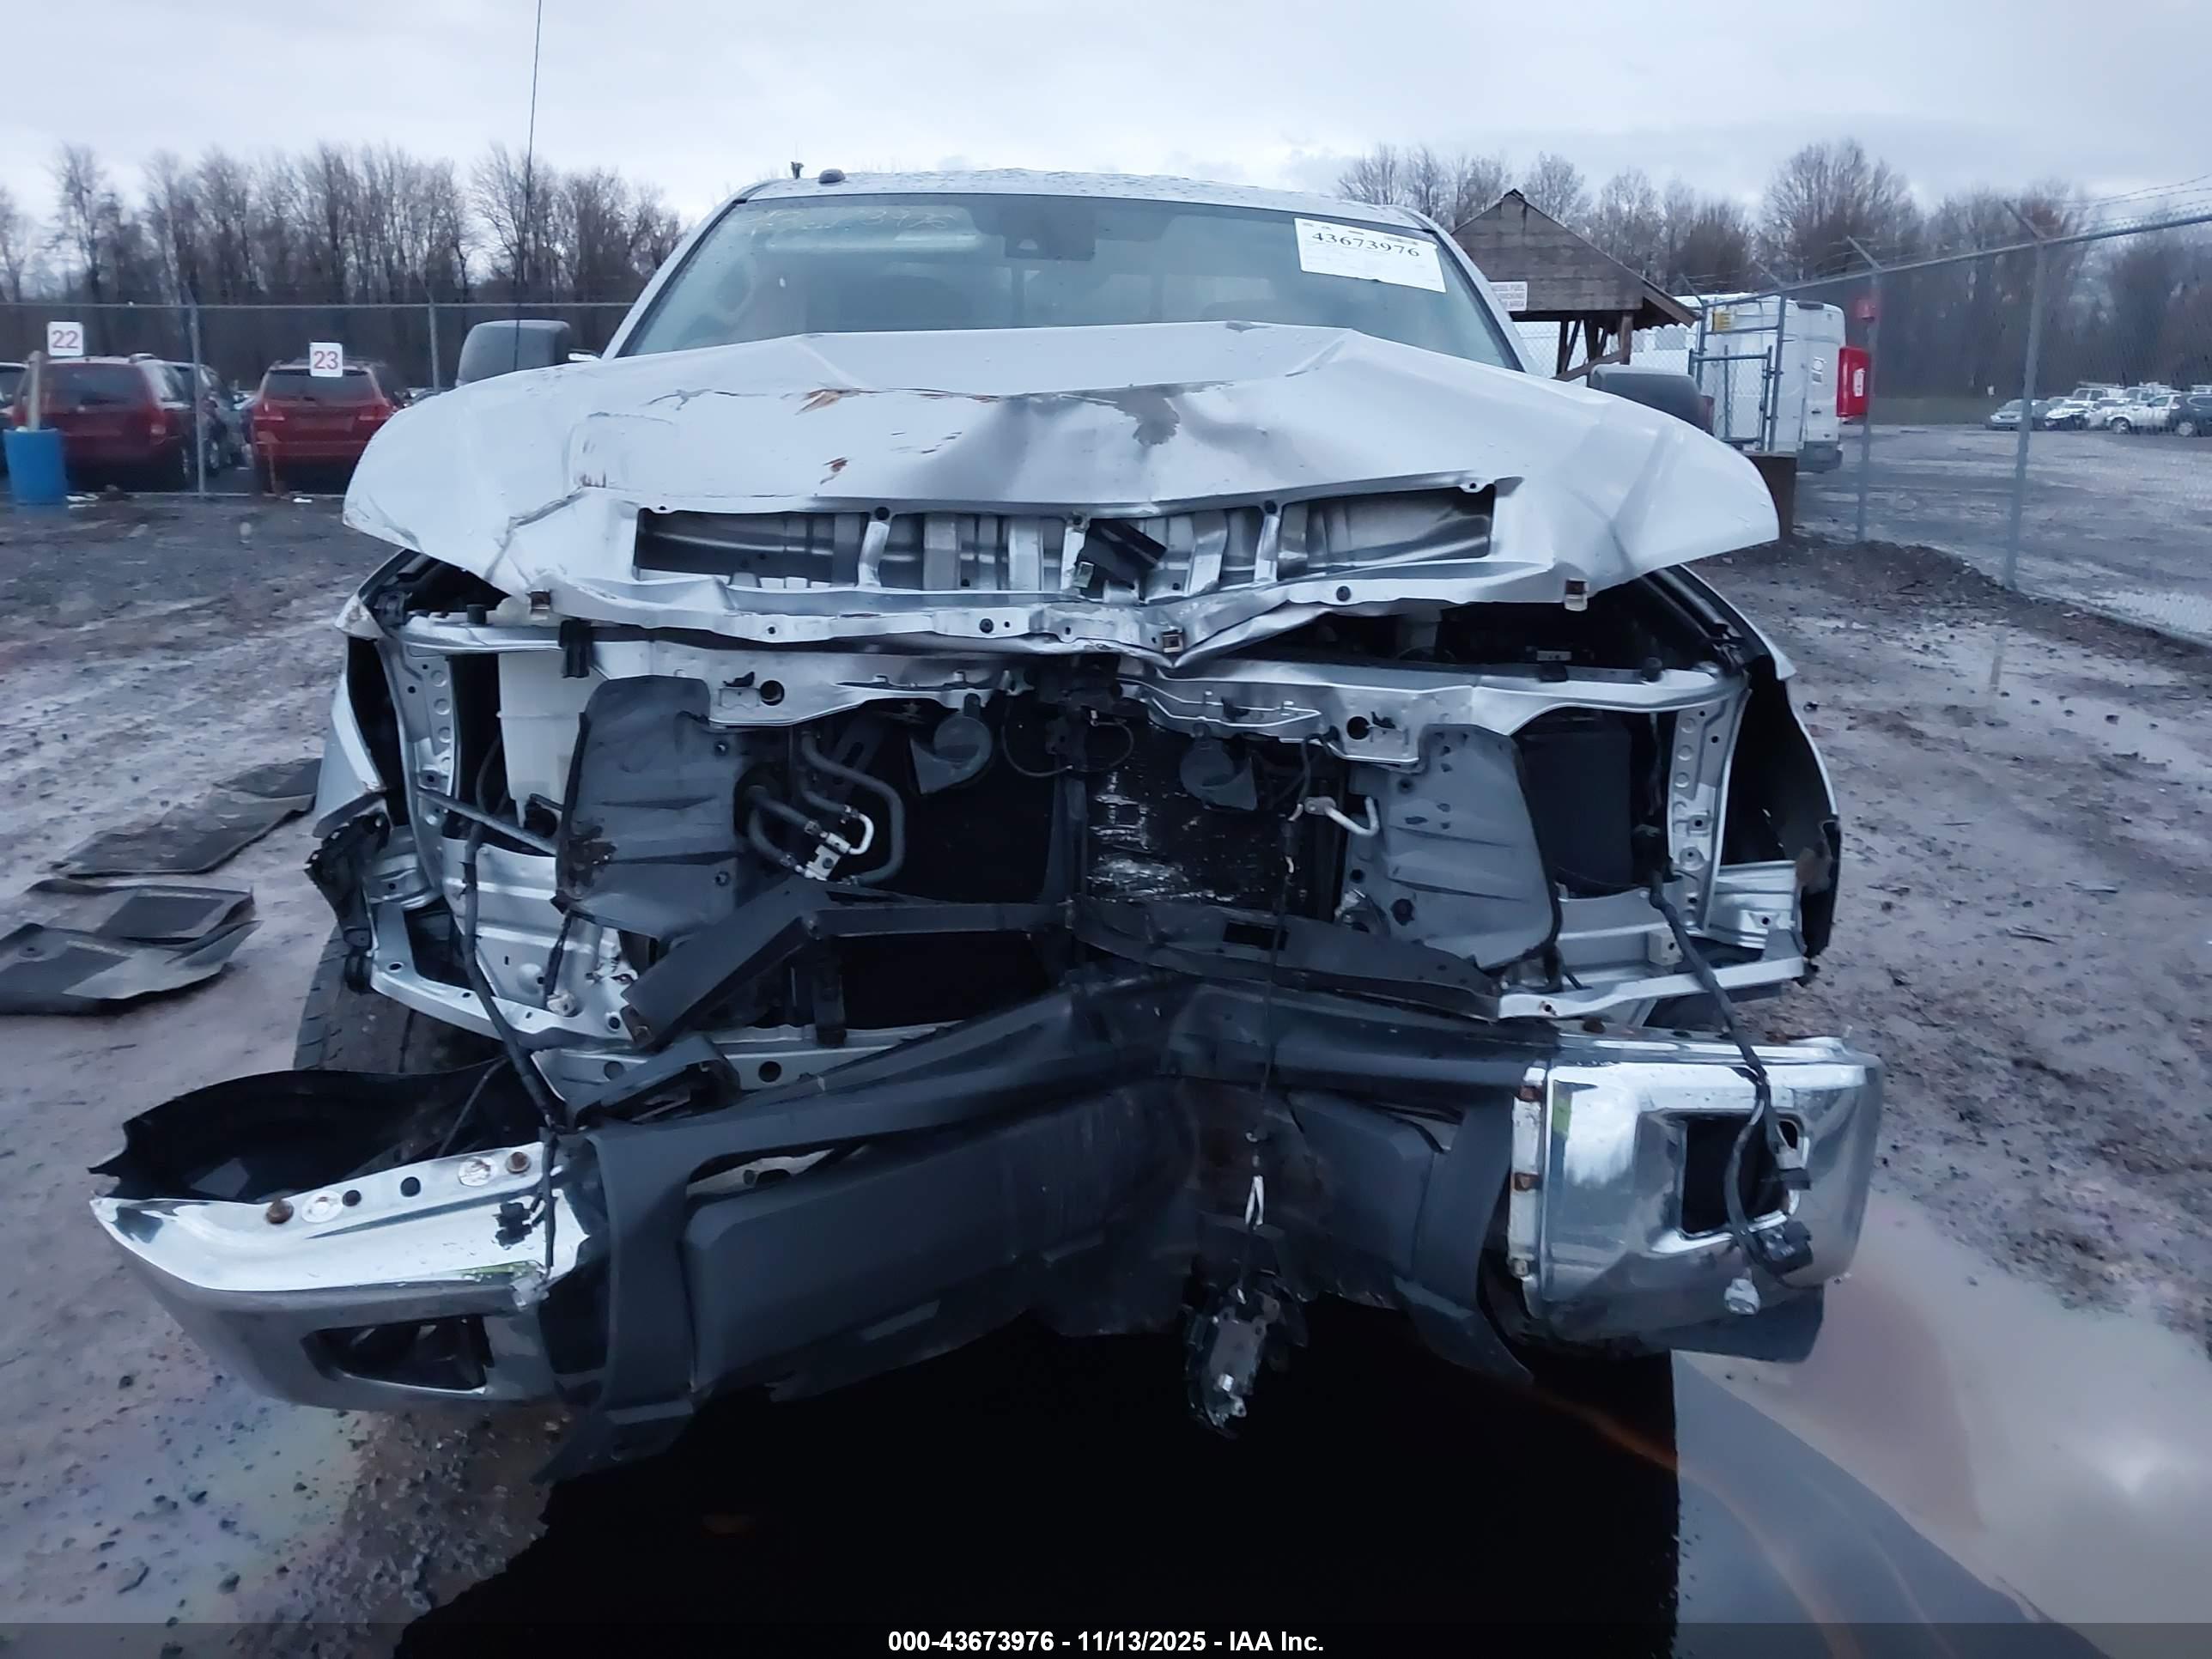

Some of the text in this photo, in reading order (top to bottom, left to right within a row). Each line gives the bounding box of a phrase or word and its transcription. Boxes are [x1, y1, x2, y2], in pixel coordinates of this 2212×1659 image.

[1311, 232, 1420, 258] 43673976
[52, 329, 79, 349] 22
[313, 350, 339, 370] 23
